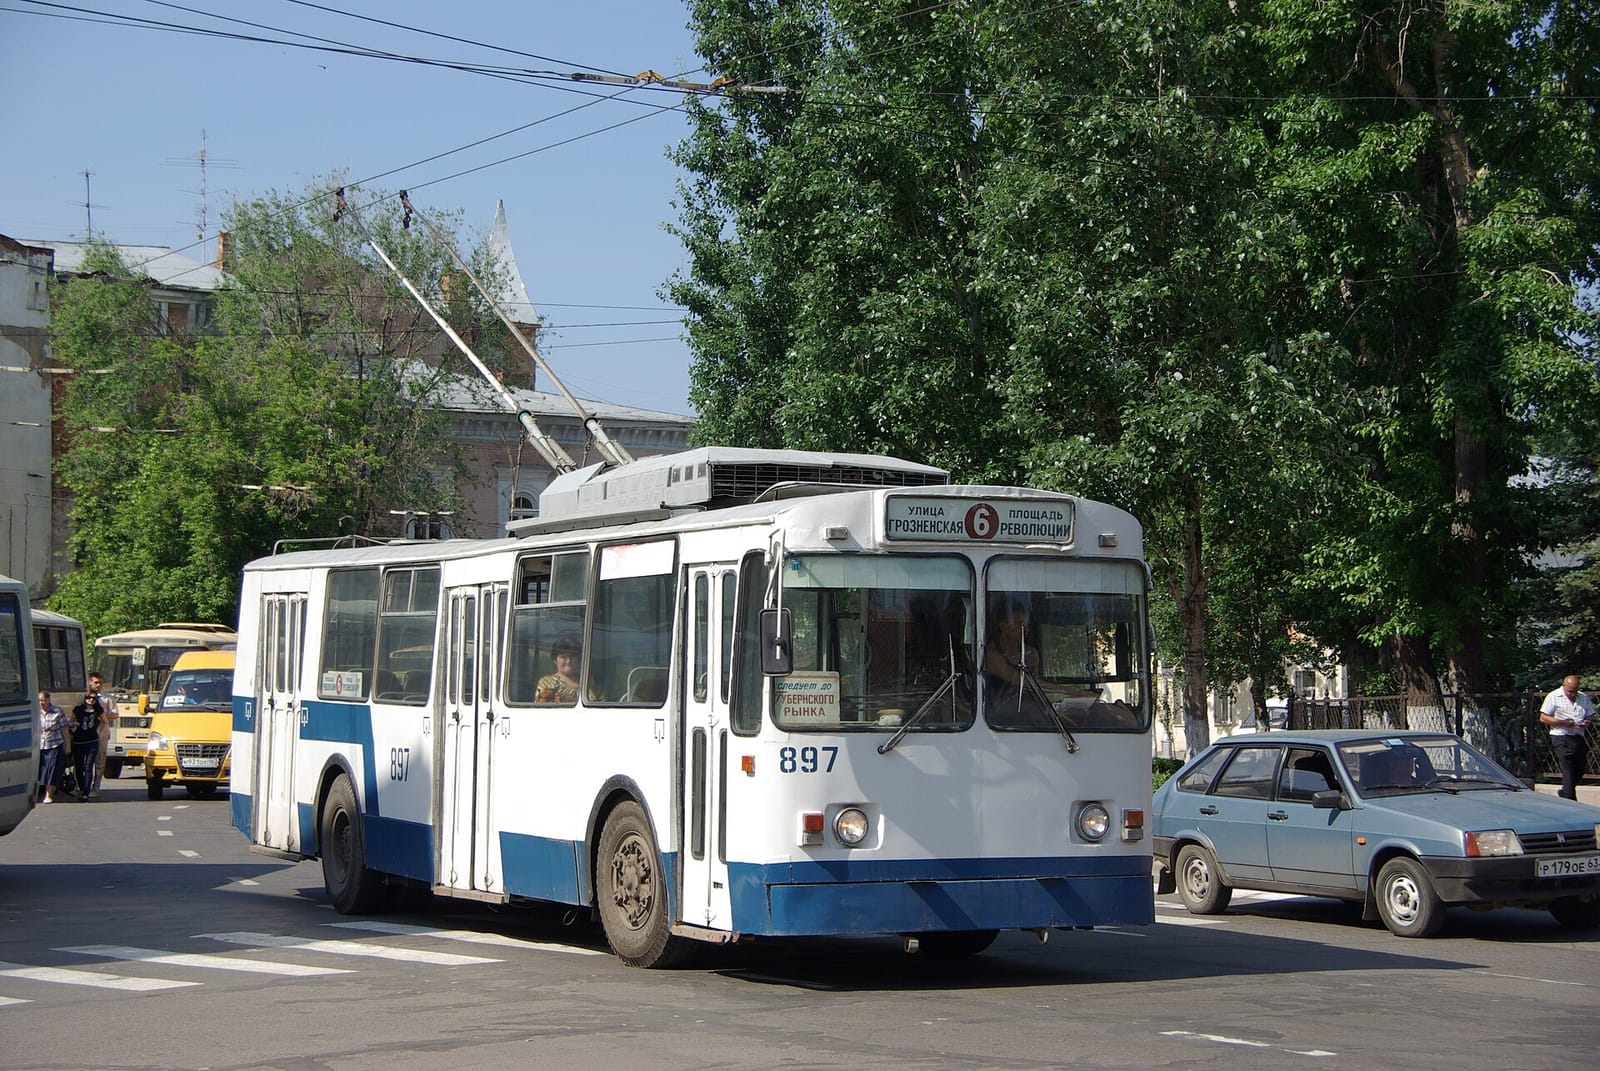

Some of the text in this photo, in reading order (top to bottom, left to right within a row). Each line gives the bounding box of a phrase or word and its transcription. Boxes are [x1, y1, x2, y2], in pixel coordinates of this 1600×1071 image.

[908, 506, 945, 518] УЛИЦА
[1009, 509, 1063, 521] ПЛОЩАДЬ
[888, 519, 964, 534] ГРОЗНЕНСКАЯ
[973, 508, 990, 536] 6
[1000, 522, 1071, 539] РЕВОЛЮЦИИ
[820, 682, 833, 690] до
[784, 707, 826, 717] РЫНКА
[390, 747, 410, 782] 897
[780, 746, 839, 773] 897
